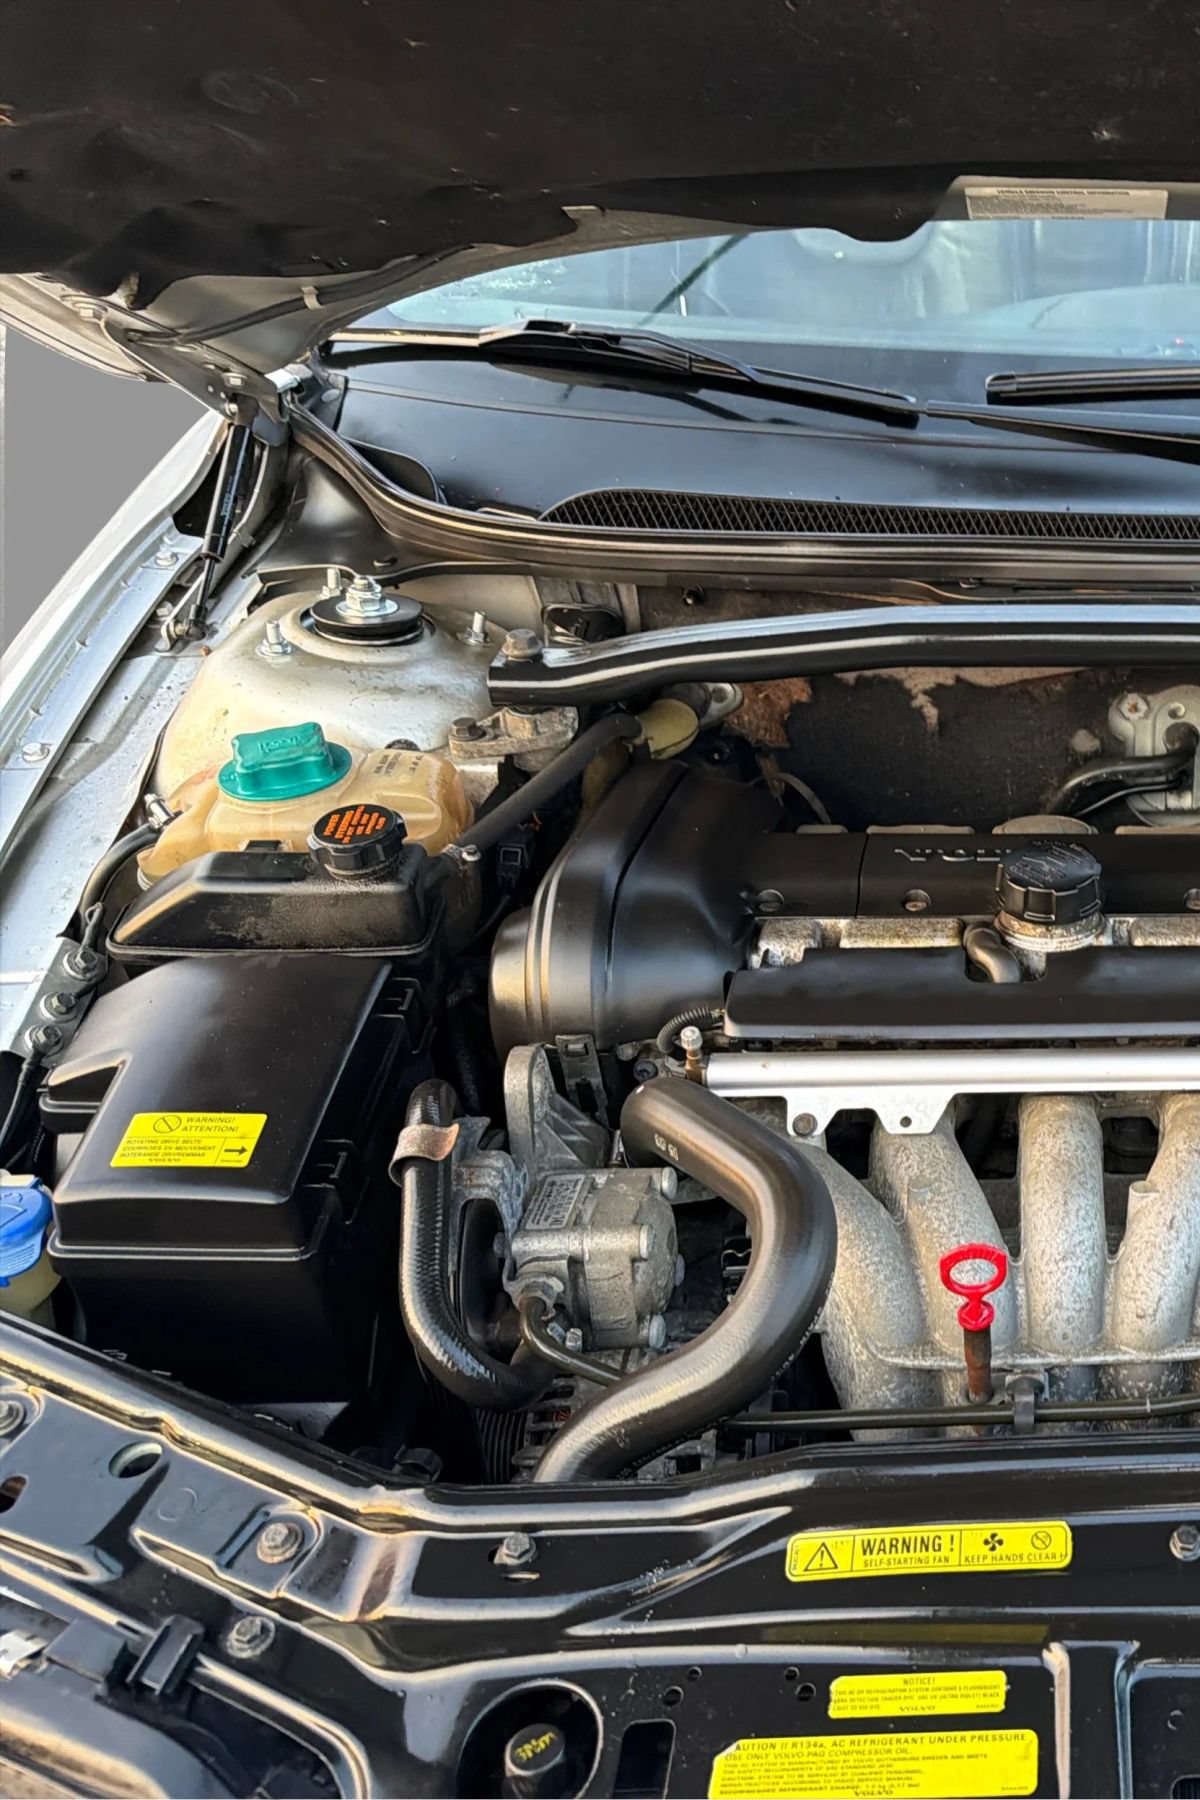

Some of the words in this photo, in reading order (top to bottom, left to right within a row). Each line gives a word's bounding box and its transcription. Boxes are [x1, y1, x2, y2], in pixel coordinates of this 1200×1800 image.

[861, 1535, 942, 1556] WARNING
[949, 1534, 954, 1552] !
[863, 1556, 929, 1568] SELF-STARTING
[933, 1555, 950, 1564] FAN
[964, 1554, 988, 1565] KEEP
[991, 1553, 1024, 1563] HANDS
[1027, 1552, 1057, 1561] CLEAR
[903, 1677, 934, 1685] NOTICE!
[831, 1740, 845, 1748] AC
[849, 1737, 924, 1747] REFRIGERANT
[928, 1735, 966, 1745] UNDER
[970, 1733, 1025, 1743] PRESSURE
[746, 1753, 769, 1761] ONLY
[774, 1751, 804, 1759] VOLVO
[828, 1748, 892, 1758] COMPRESSOR
